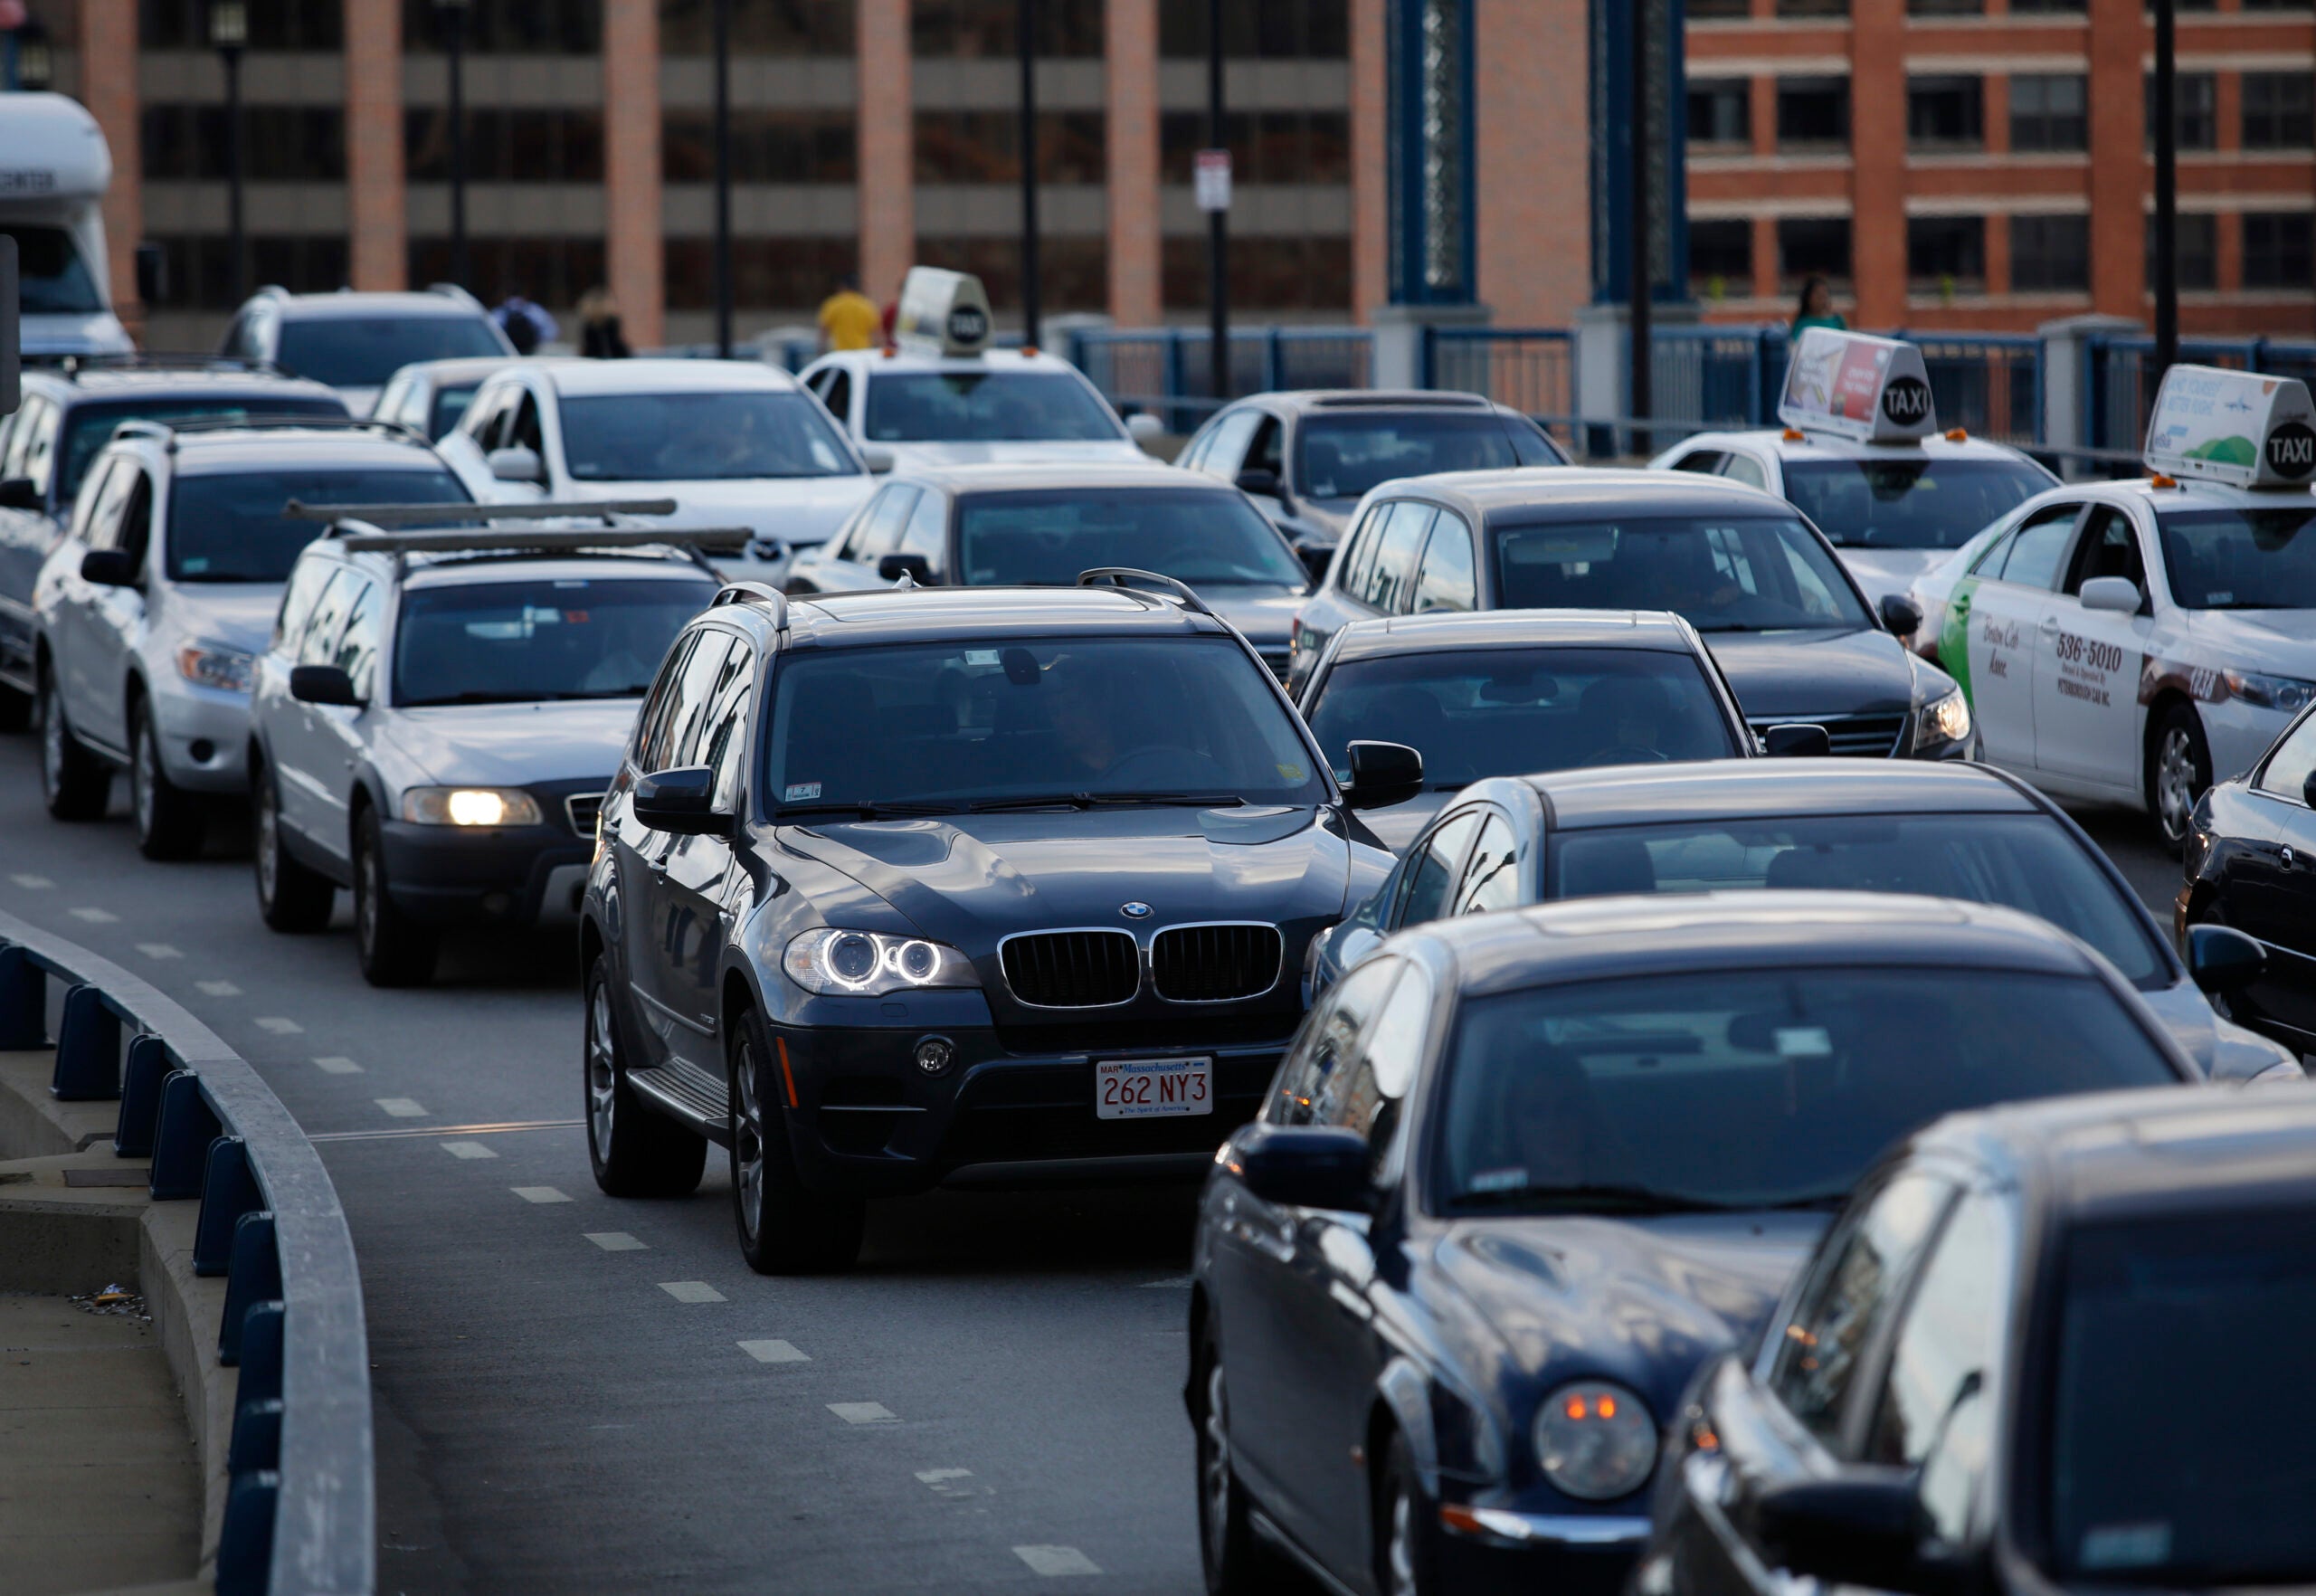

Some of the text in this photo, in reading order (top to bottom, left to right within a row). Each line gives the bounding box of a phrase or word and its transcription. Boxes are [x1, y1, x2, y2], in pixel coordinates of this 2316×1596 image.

[1886, 385, 1930, 415] TAXI
[2270, 437, 2313, 464] TAXI
[2057, 632, 2122, 673] 536-5010
[1100, 1062, 1186, 1074] MAR Massachusetts
[1104, 1073, 1207, 1106] 262 NY3
[1136, 1106, 1153, 1115] Spirit
[1160, 1105, 1186, 1113] America
